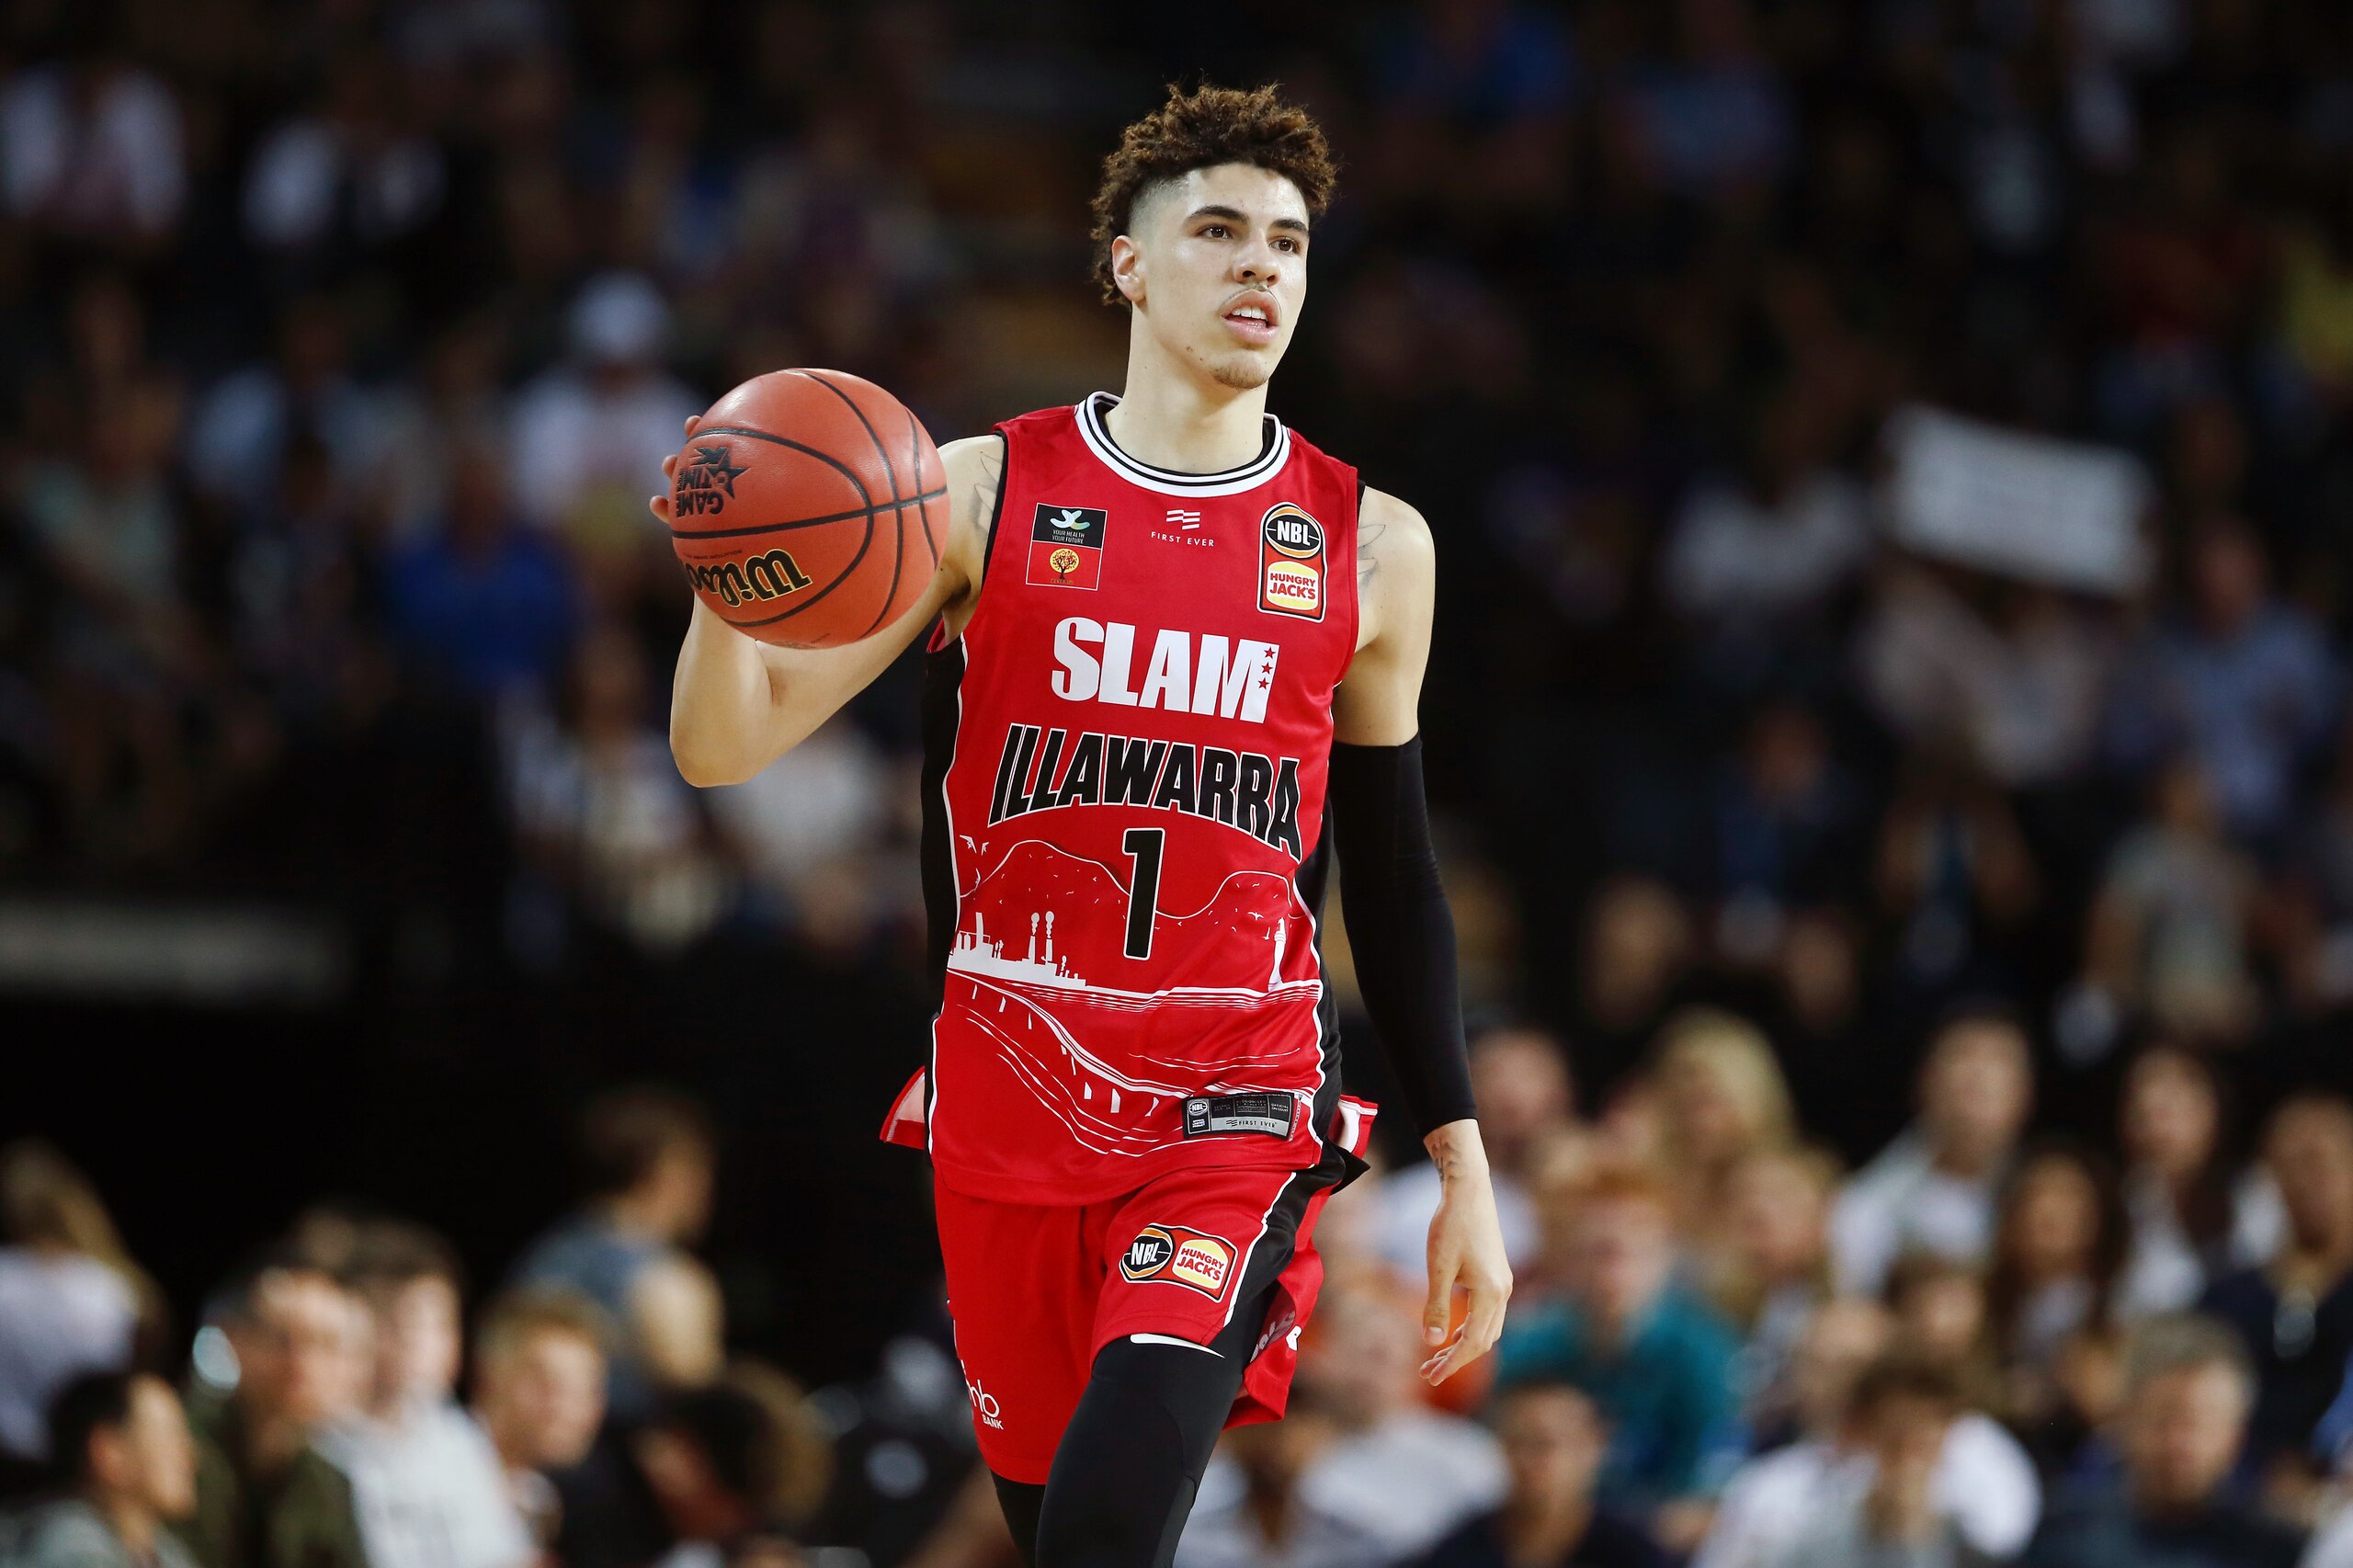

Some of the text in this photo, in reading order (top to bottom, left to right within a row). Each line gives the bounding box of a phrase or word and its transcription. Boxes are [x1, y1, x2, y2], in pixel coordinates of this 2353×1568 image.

[676, 492, 723, 517] GAME
[1151, 531, 1214, 547] FIRST EVER
[1277, 520, 1311, 546] NBL
[685, 548, 813, 608] Wilso
[1269, 573, 1316, 587] HUNGRY
[1269, 582, 1316, 600] JACK'S
[1051, 617, 1280, 724] SLAM
[987, 722, 1302, 865] ILLAWARRA
[1121, 827, 1165, 960] 1
[1191, 1103, 1204, 1111] NBL
[1131, 1242, 1160, 1266] NBL
[1180, 1247, 1224, 1269] HUNGRY
[1176, 1256, 1222, 1281] JACK'S
[982, 1414, 1004, 1430] BANK
